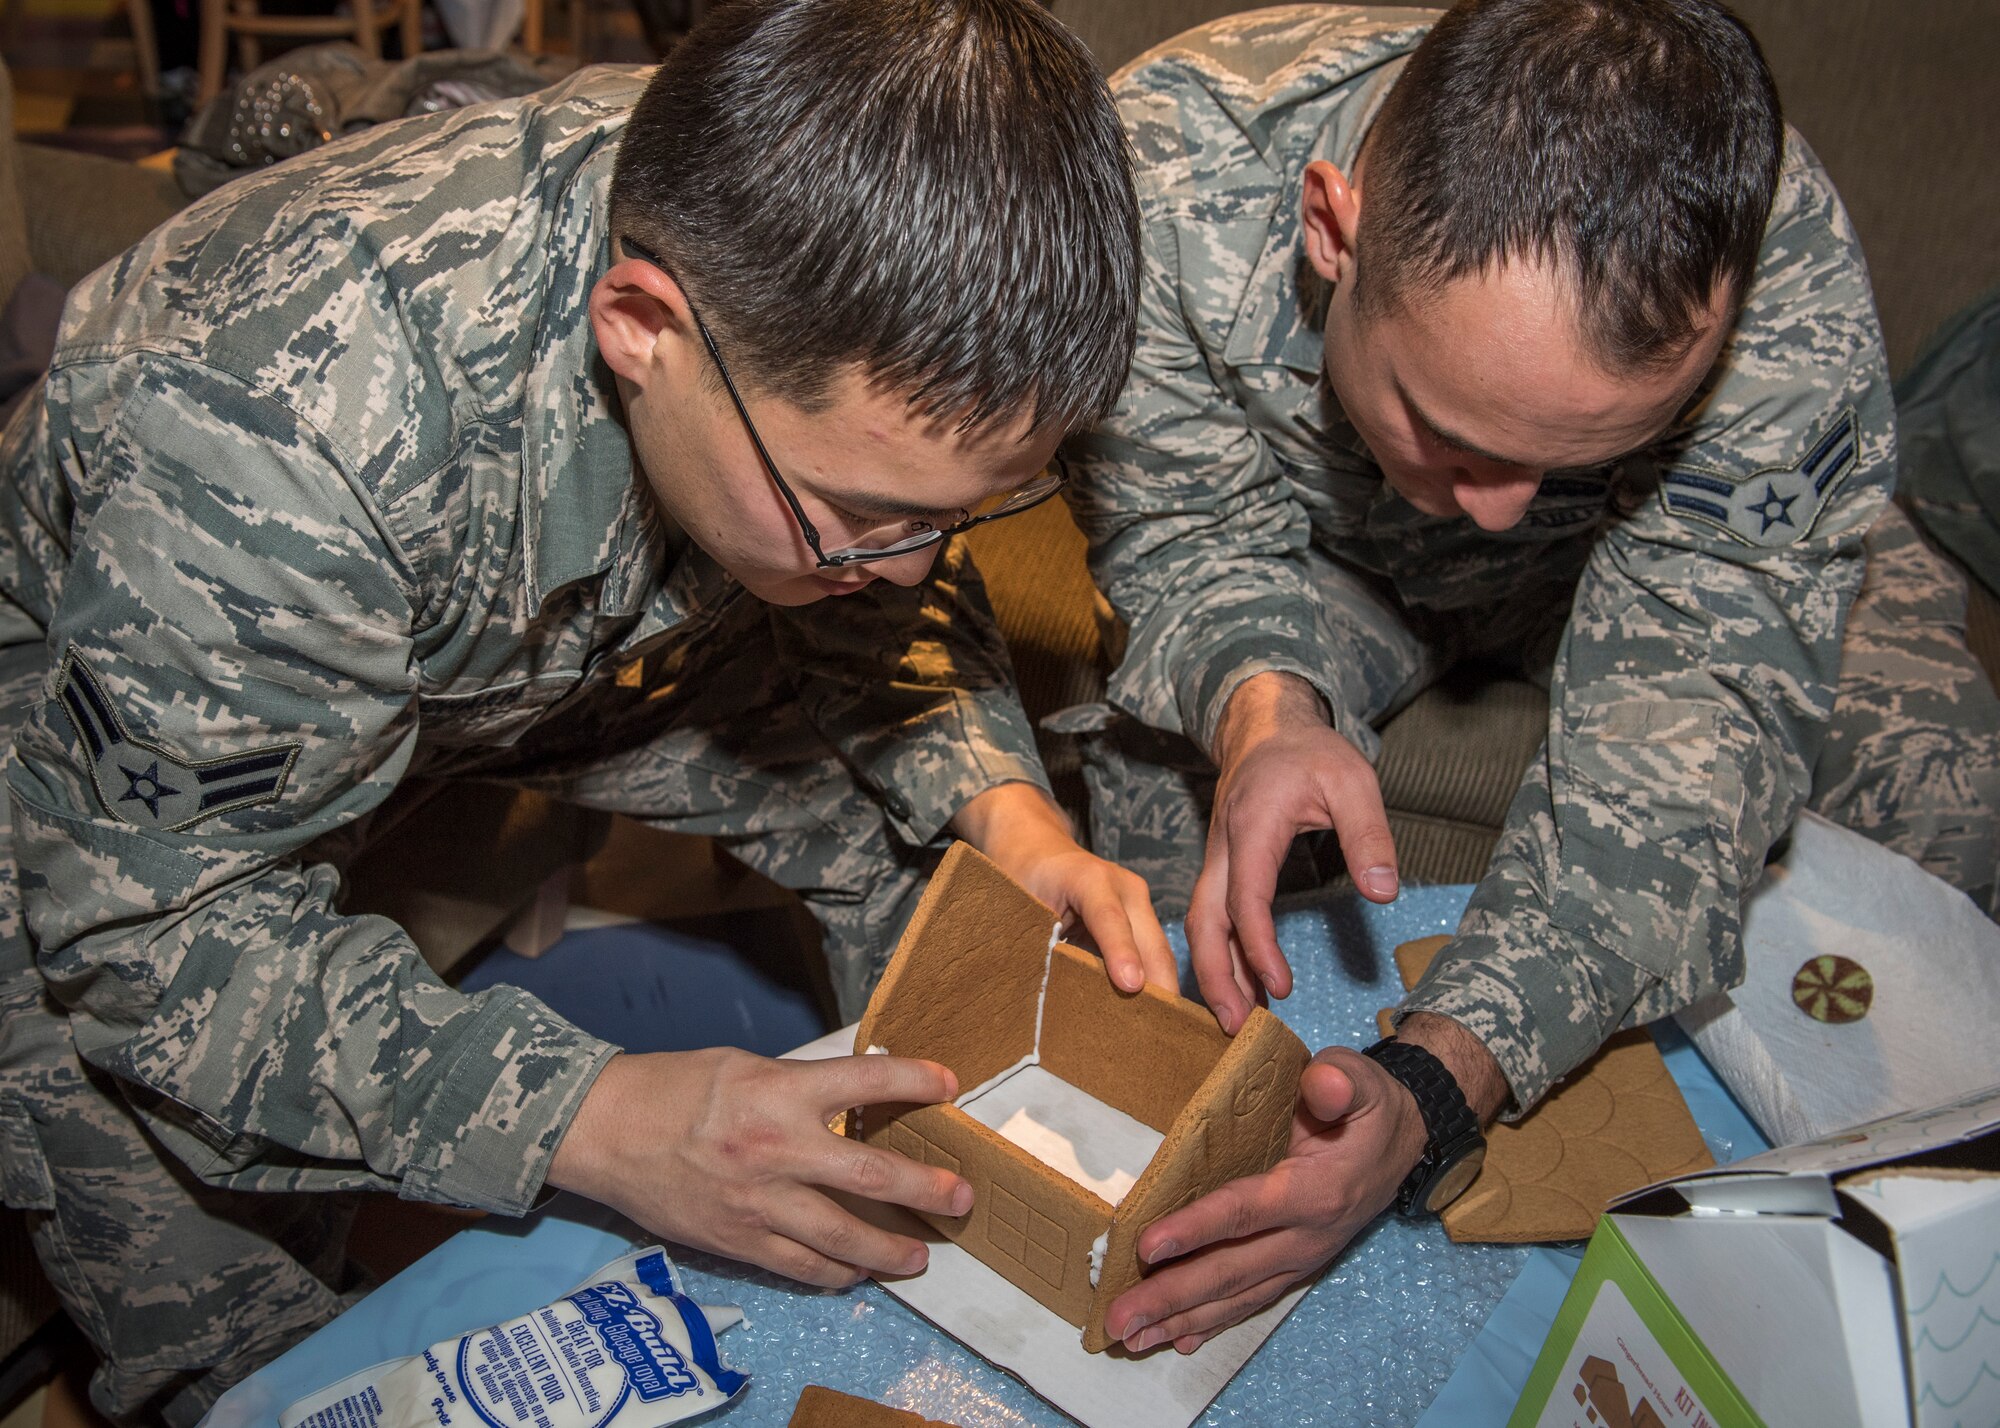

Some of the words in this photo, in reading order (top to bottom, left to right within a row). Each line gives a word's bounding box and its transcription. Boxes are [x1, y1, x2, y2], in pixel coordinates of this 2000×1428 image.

[540, 1309, 564, 1338] Building
[594, 1283, 692, 1389] EZ-Build
[479, 1340, 500, 1364] d'épice
[556, 1335, 570, 1345] &
[565, 1320, 595, 1349] GREAT
[581, 1348, 605, 1369] FOR
[582, 1299, 612, 1321] Icing
[605, 1323, 644, 1364] Glaçage
[632, 1363, 668, 1394] royal
[475, 1364, 489, 1375] de
[493, 1362, 506, 1373] et
[508, 1357, 523, 1371] des
[510, 1324, 551, 1375] EXCELLENT
[537, 1373, 565, 1405] POUR
[560, 1343, 581, 1368] Cookie
[480, 1372, 504, 1405] biscuits
[497, 1372, 509, 1380] la
[514, 1370, 539, 1405] trousses
[574, 1367, 602, 1413] Decorating
[431, 1397, 452, 1427] Prêt
[501, 1379, 529, 1422] décoration
[531, 1404, 545, 1417] en
[1674, 1386, 1696, 1416] KIT
[535, 1416, 555, 1428] pai
